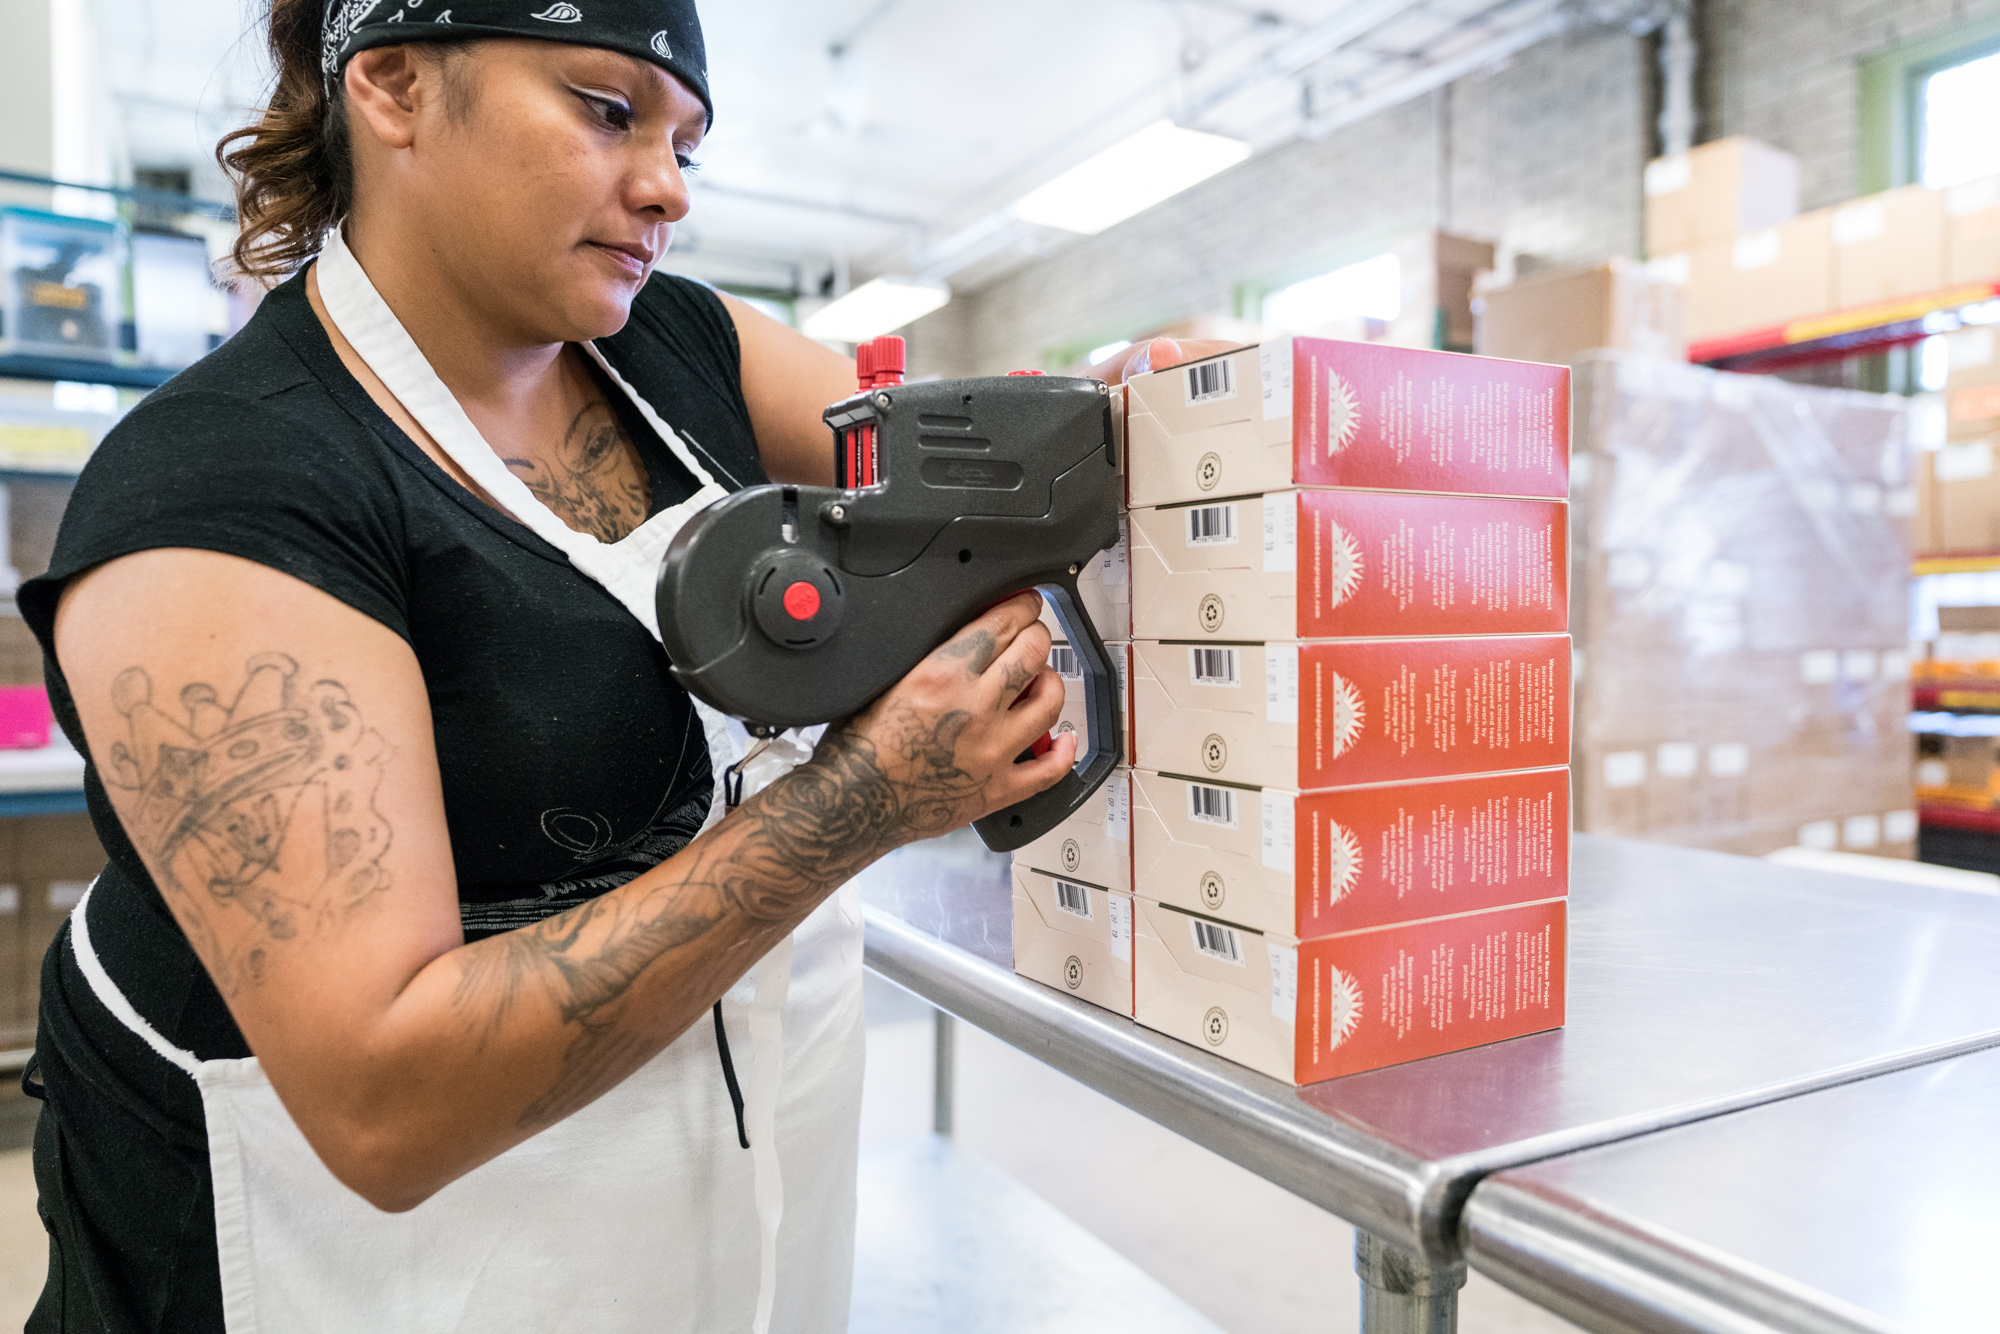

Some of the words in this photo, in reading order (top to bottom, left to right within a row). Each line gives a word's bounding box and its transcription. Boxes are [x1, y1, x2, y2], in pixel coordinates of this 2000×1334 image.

[1119, 553, 1125, 563] BY
[1505, 660, 1511, 670] So
[1505, 672, 1510, 683] we
[1118, 680, 1124, 691] BY
[1482, 696, 1488, 704] to
[1481, 727, 1487, 737] by
[1108, 798, 1114, 807] 09
[1503, 796, 1508, 807] So
[1108, 813, 1114, 821] 19
[1121, 811, 1126, 822] BY
[1503, 808, 1507, 820] we
[1480, 833, 1485, 842] to
[1479, 864, 1485, 874] by
[1532, 862, 1538, 870] to
[1110, 915, 1117, 924] 09
[1112, 930, 1118, 938] 19
[1124, 929, 1130, 940] BY
[1530, 994, 1535, 1003] to
